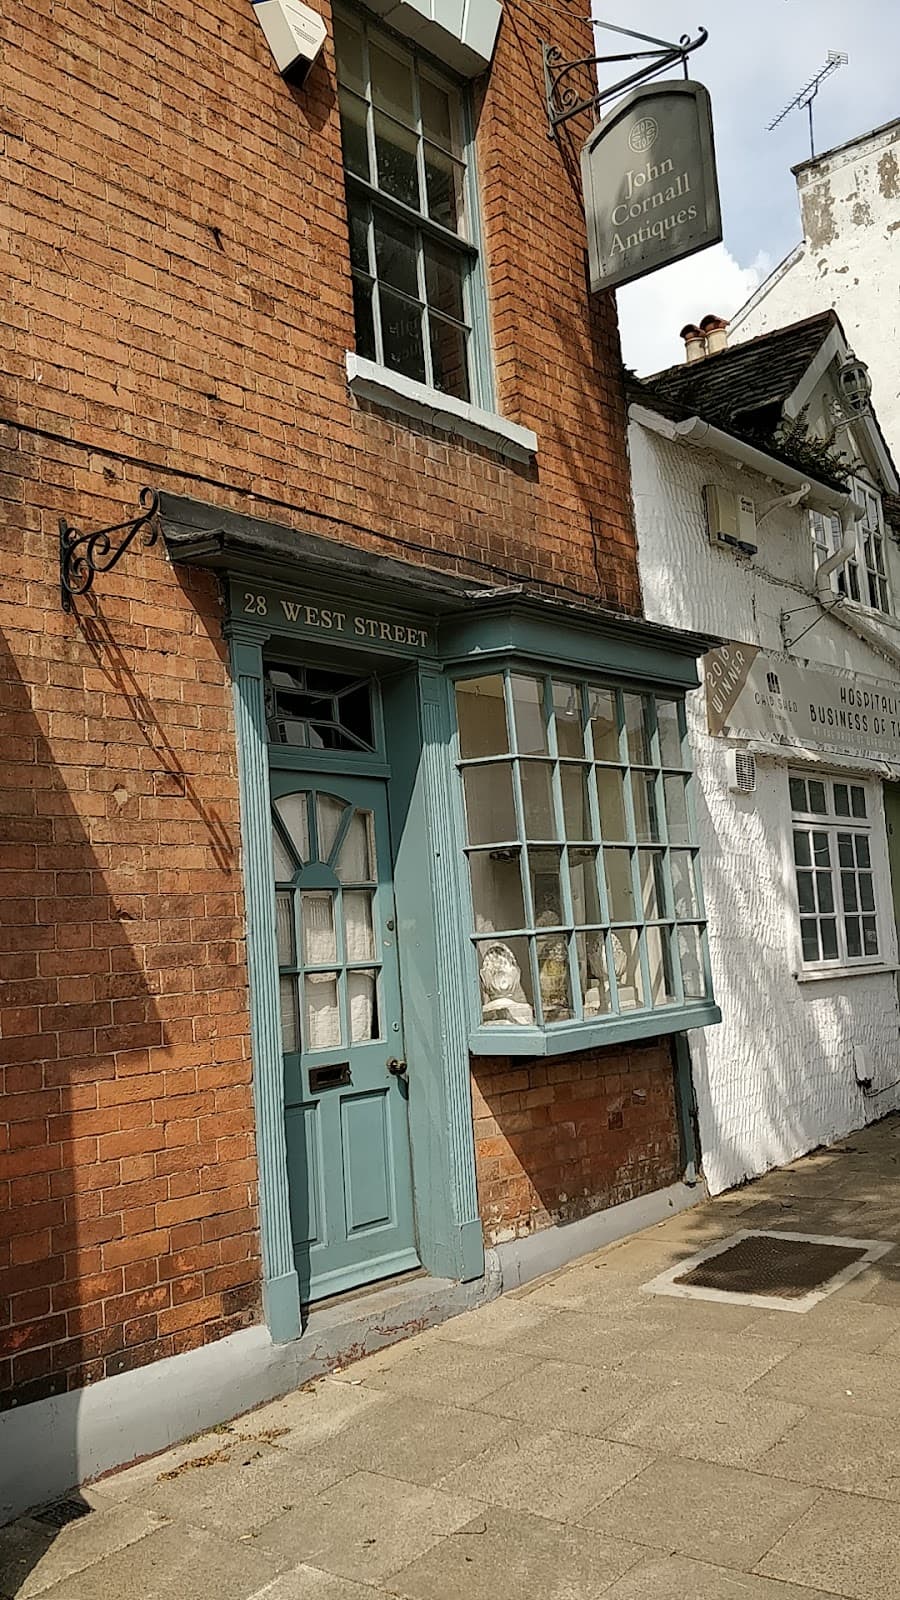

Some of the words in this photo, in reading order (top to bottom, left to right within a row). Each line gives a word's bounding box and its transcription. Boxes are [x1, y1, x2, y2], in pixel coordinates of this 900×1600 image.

[611, 172, 690, 227] Cornall
[624, 157, 674, 200] John
[609, 203, 697, 257] Antiques
[244, 593, 268, 616] 28
[280, 600, 346, 631] WEST
[354, 616, 429, 648] STREET
[711, 650, 745, 713] WINNER
[840, 687, 900, 715] HOSPITALI
[809, 704, 868, 732] BUSINESS
[873, 717, 886, 735] OF
